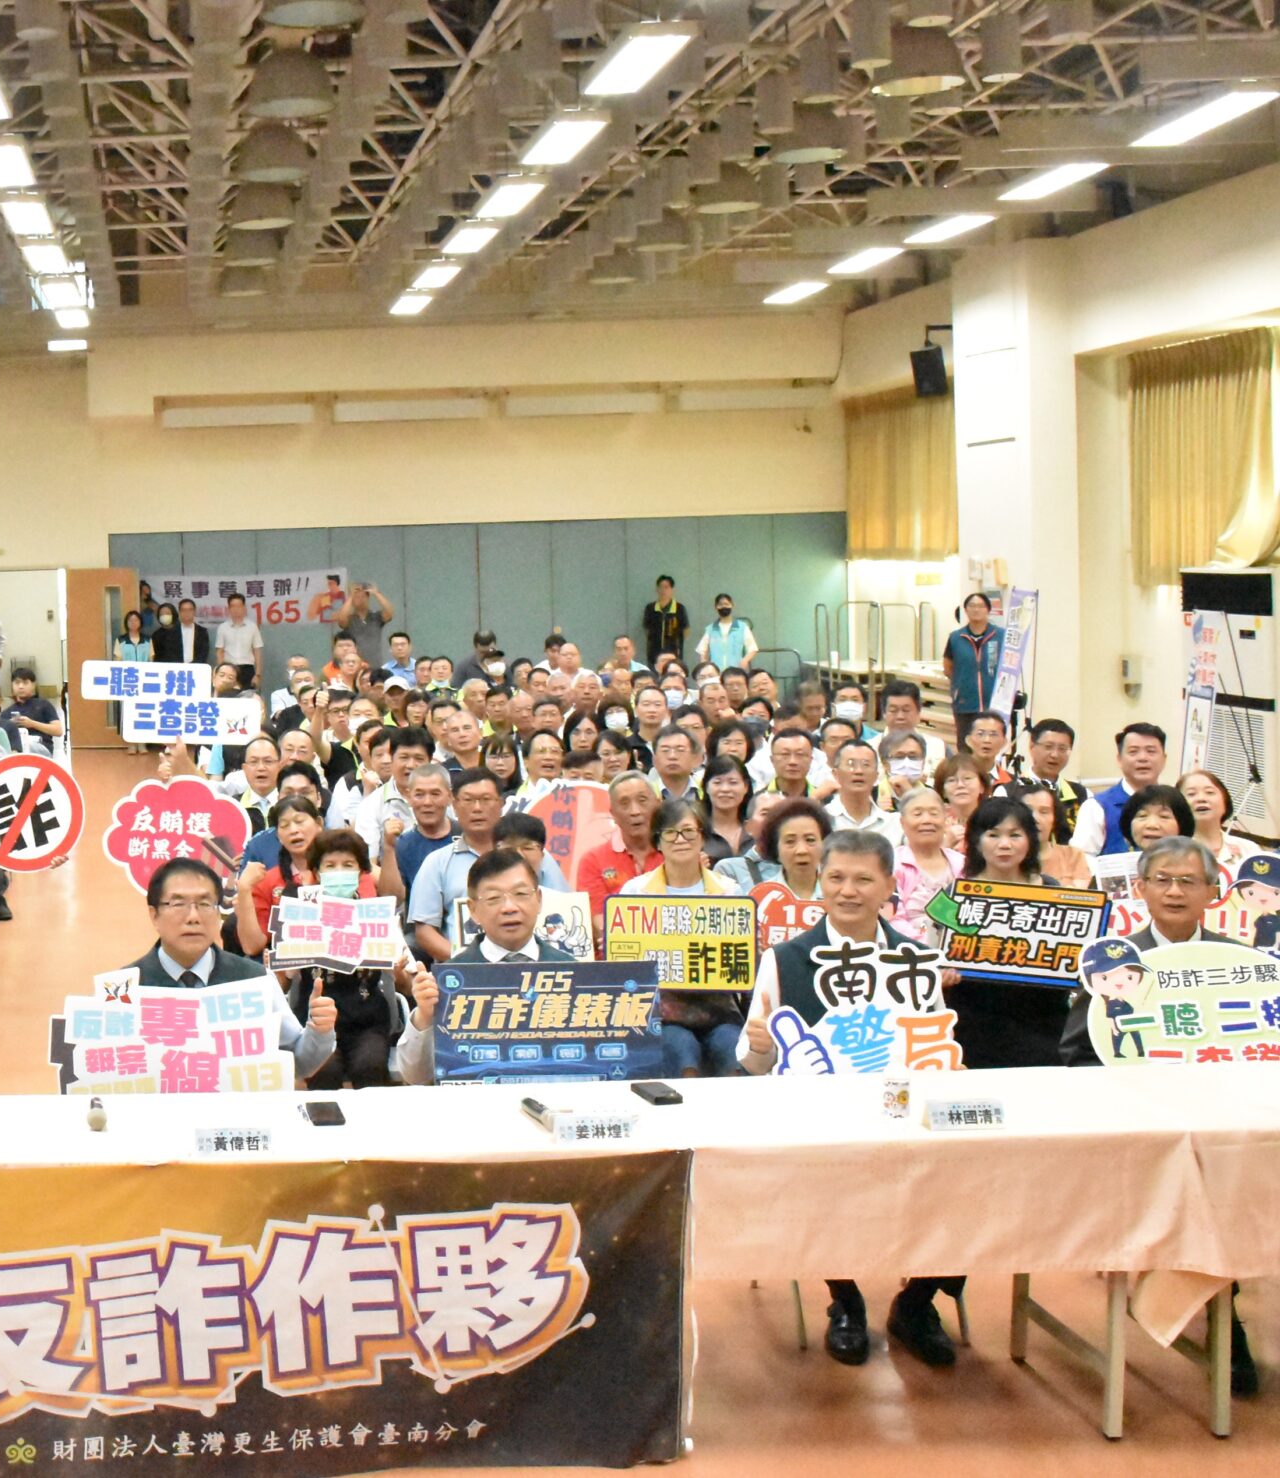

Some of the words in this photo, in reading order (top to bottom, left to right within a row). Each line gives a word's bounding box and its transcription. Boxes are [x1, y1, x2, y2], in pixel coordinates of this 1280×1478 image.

[251, 600, 301, 627] 165
[93, 666, 196, 697] 一聽二掛
[133, 700, 220, 737] 三查證
[130, 805, 216, 839] 反賄選
[356, 903, 391, 919] 165
[609, 905, 751, 936] ATM解除分期付款
[957, 899, 1093, 937] 帳戶寄出門
[359, 922, 389, 939] 110
[947, 934, 1084, 971] 刑責找上門
[520, 970, 574, 993] 165
[815, 941, 940, 1011] 南市
[1157, 960, 1280, 990] 防詐三步驟
[201, 990, 266, 1025] 165
[446, 991, 656, 1030] 打詐儀錶板
[73, 1009, 135, 1040] 反詐
[825, 1003, 960, 1073] 警局
[210, 1027, 266, 1059] 110
[226, 1061, 282, 1092] 113
[947, 1108, 994, 1125] 林國清
[213, 1135, 261, 1152] 黃偉哲
[52, 1418, 488, 1463] 財團法人臺灣更生保護會臺南分會
